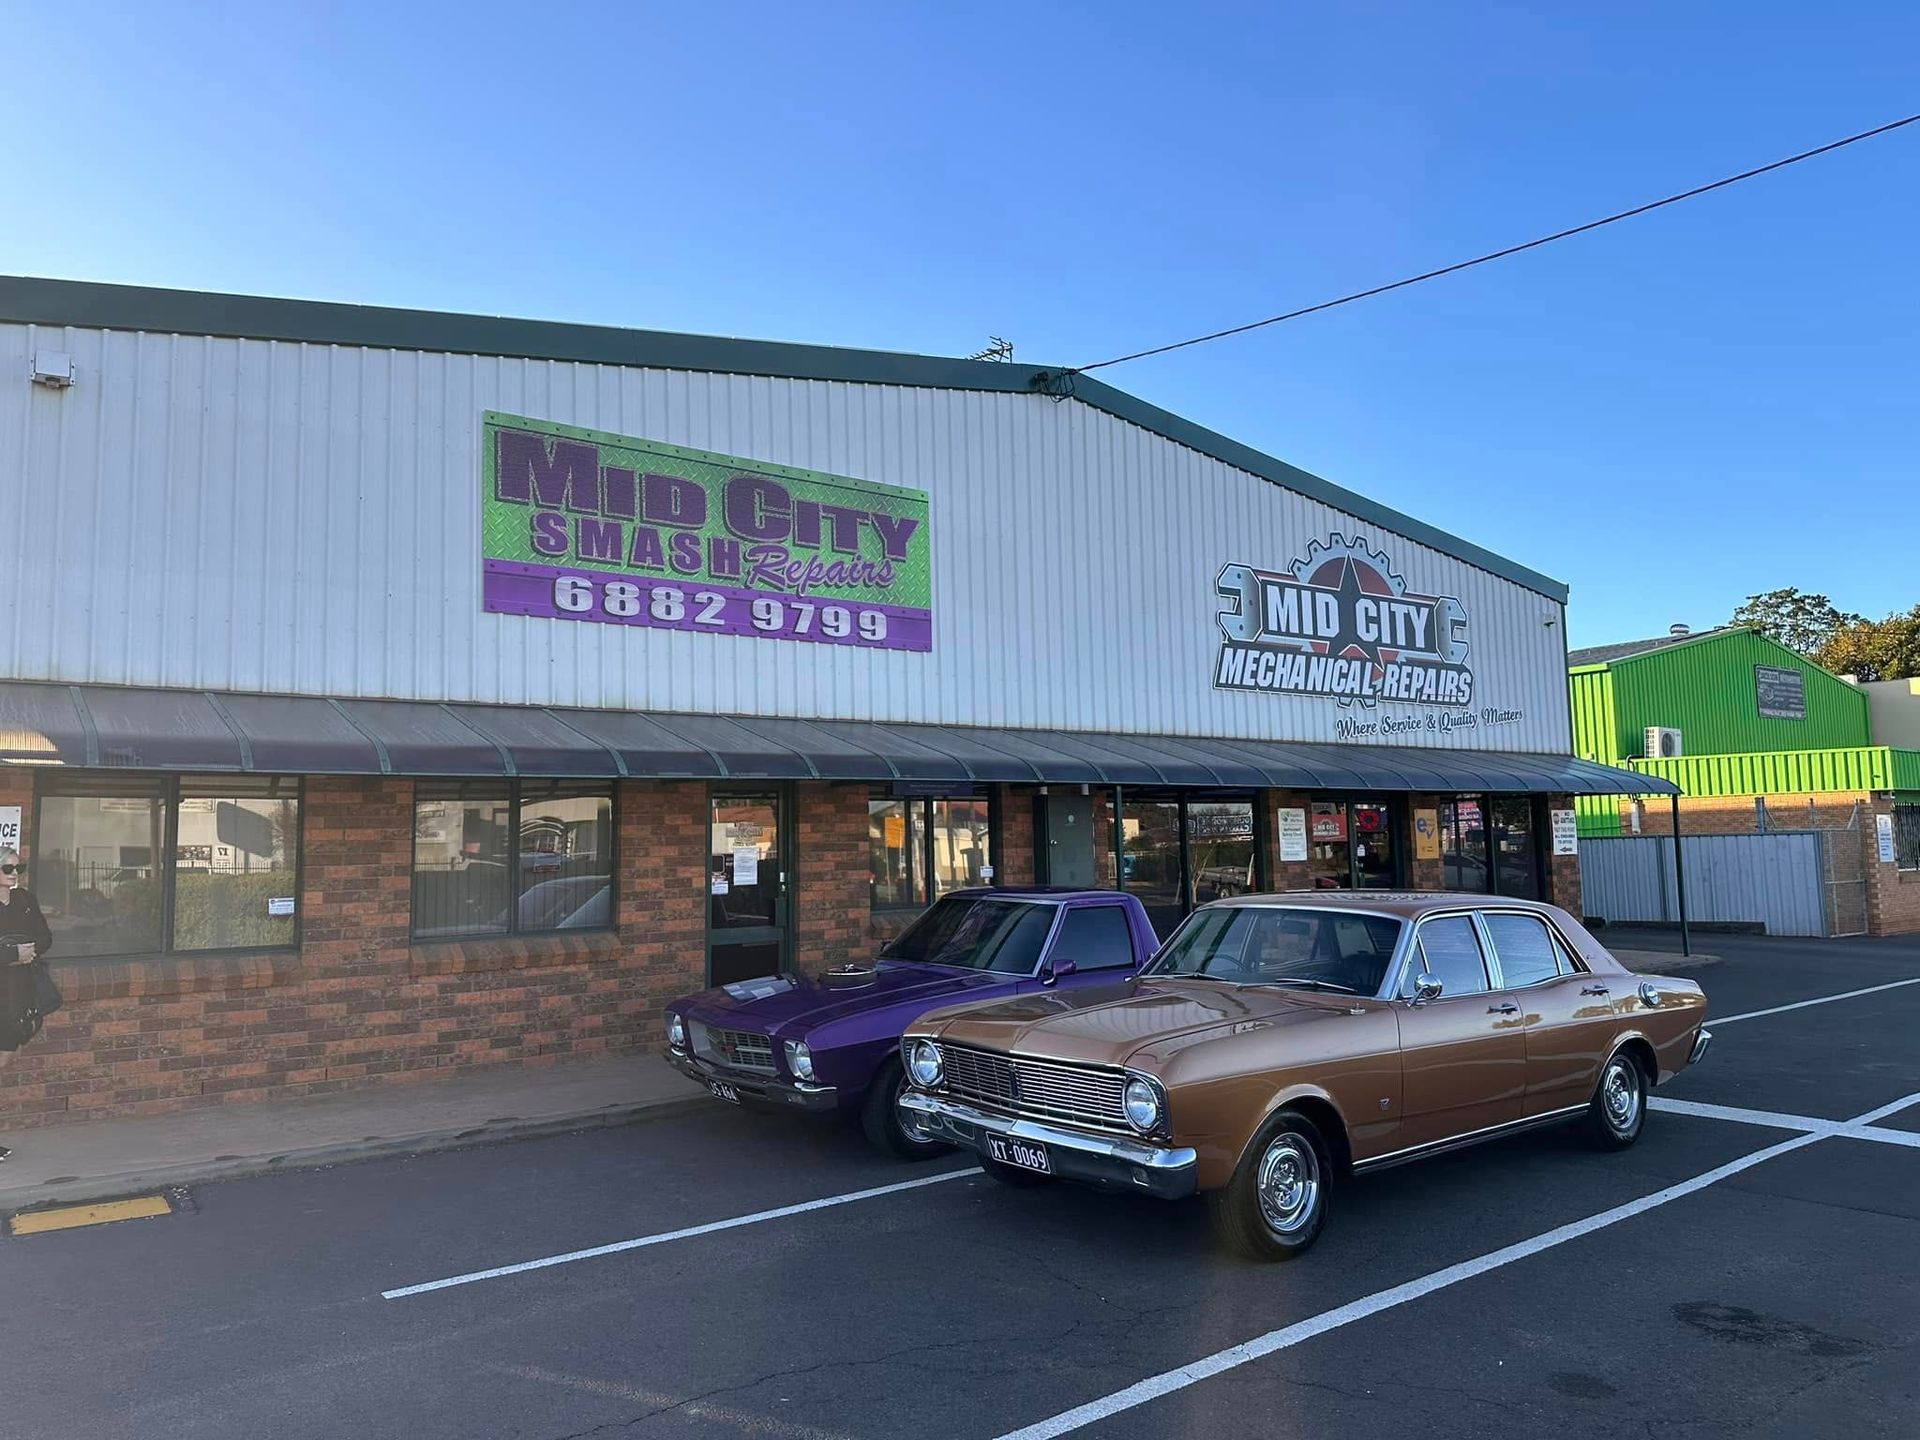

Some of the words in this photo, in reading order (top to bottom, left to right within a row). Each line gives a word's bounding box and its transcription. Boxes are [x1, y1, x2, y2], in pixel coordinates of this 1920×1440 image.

[495, 429, 707, 530] MID
[722, 474, 920, 562] CITY
[530, 511, 741, 579] SMASH
[745, 544, 898, 596] Repairs
[552, 575, 727, 626] 6882
[750, 599, 888, 642] 9799
[1266, 584, 1340, 638] MID
[1355, 598, 1429, 648] CITY
[1219, 647, 1376, 695] MECHANICAL
[1383, 663, 1473, 703] REPAIRS
[1336, 716, 1377, 740] Where
[1381, 715, 1422, 735] Service
[1425, 714, 1436, 732] &
[1439, 711, 1478, 734] Quality
[1481, 707, 1523, 726] Matters
